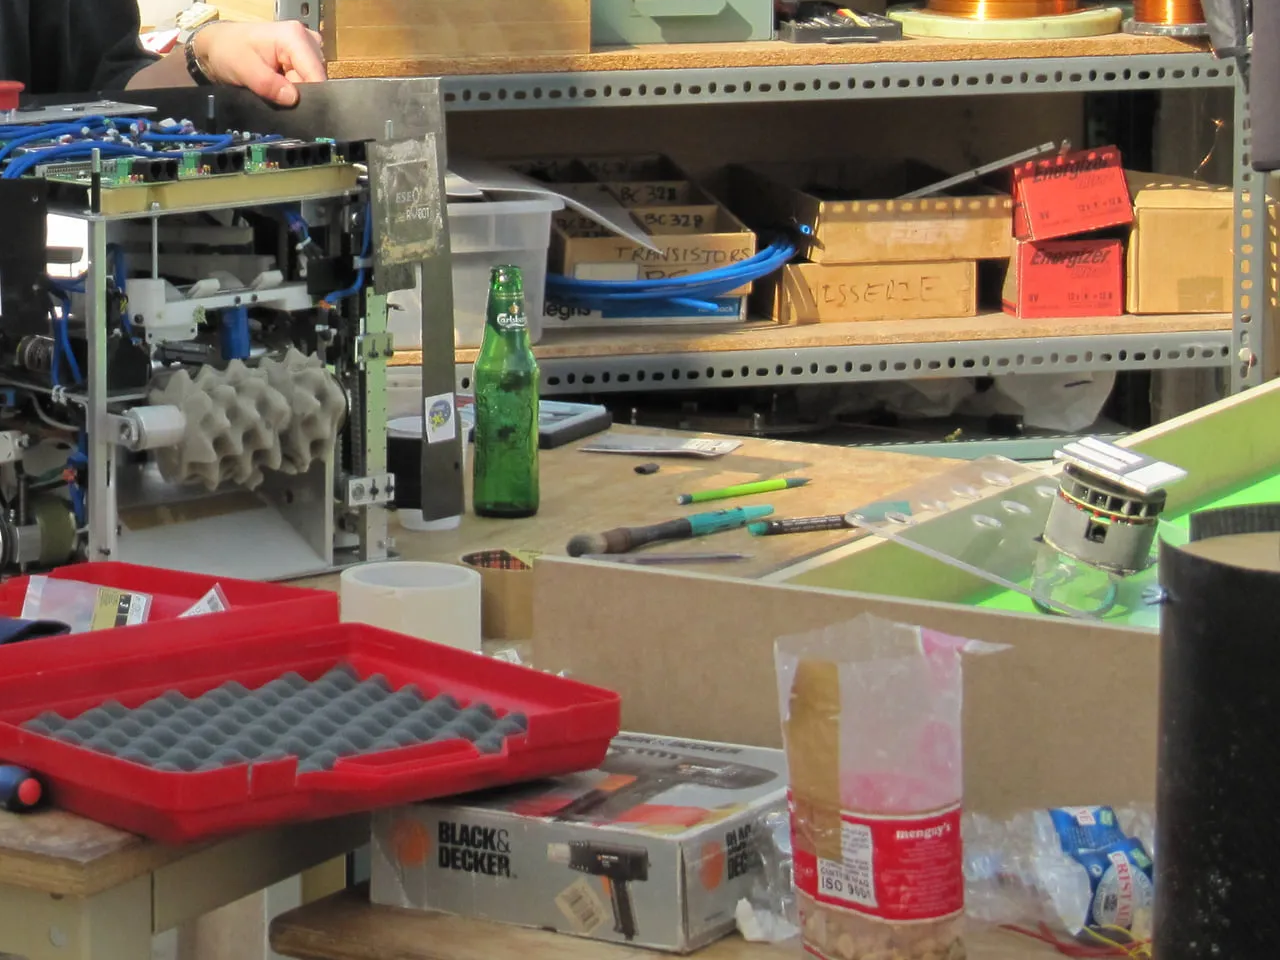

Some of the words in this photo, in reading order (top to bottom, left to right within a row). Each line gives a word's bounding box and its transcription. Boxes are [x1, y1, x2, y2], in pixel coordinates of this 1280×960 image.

[614, 246, 752, 264] TRANSISTORS
[1029, 247, 1111, 269] Energizer
[895, 821, 952, 841] menguy's
[437, 846, 512, 880] DECKER
[821, 875, 843, 892] ISO
